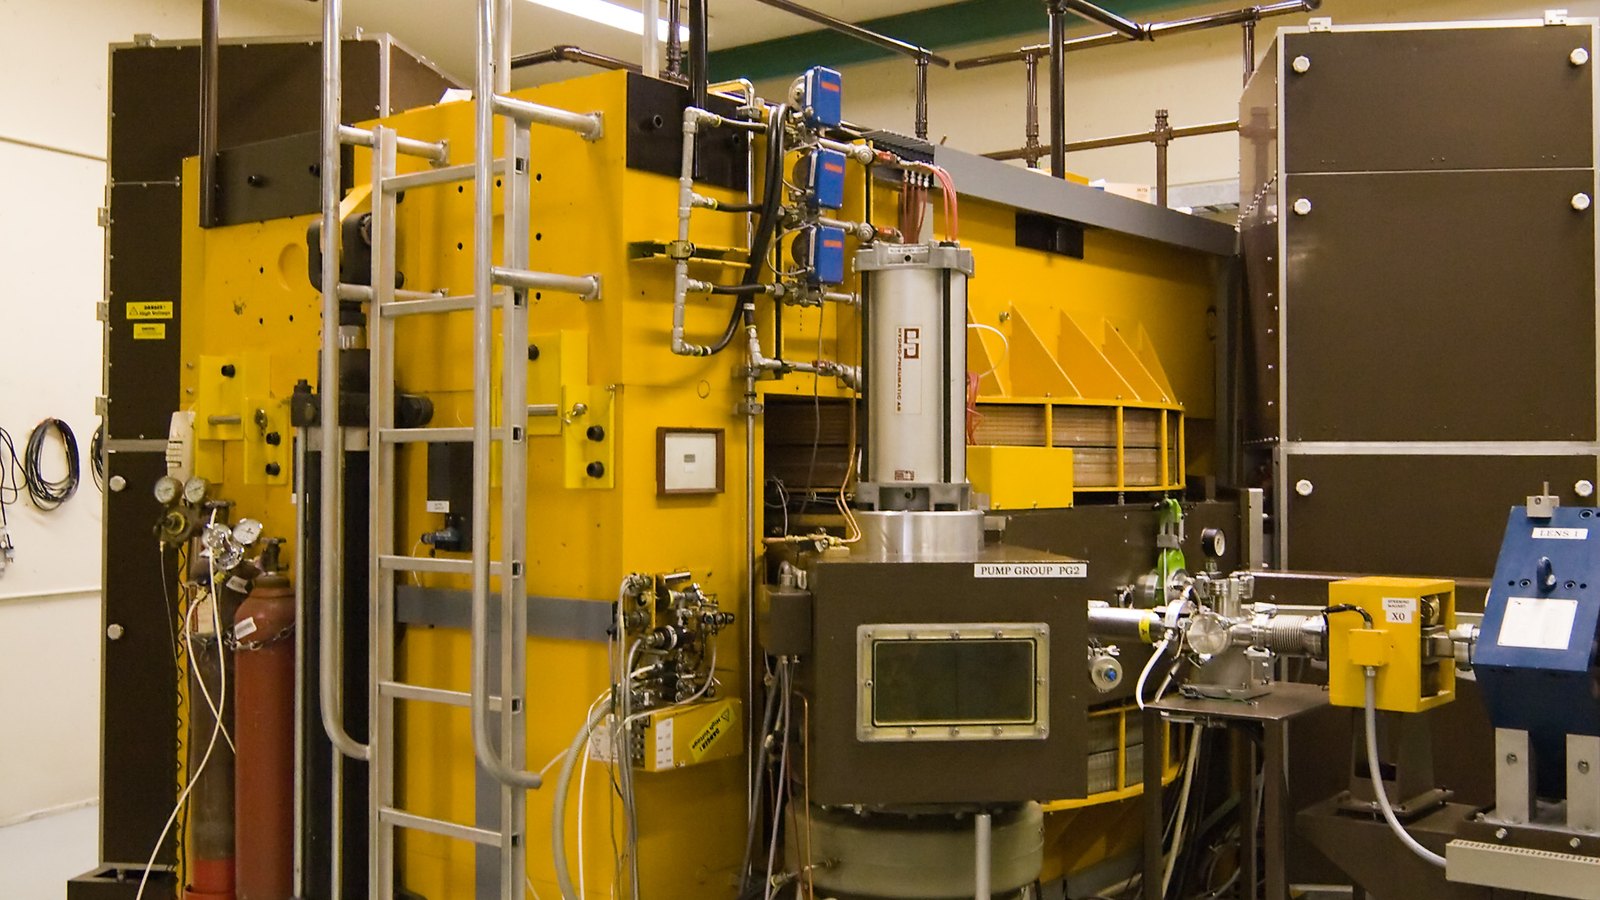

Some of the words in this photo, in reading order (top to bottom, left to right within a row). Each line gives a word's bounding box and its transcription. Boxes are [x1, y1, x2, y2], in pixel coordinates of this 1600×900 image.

[981, 566, 1011, 575] PUMP
[1014, 566, 1053, 575] GROUP
[1059, 566, 1080, 575] PG2
